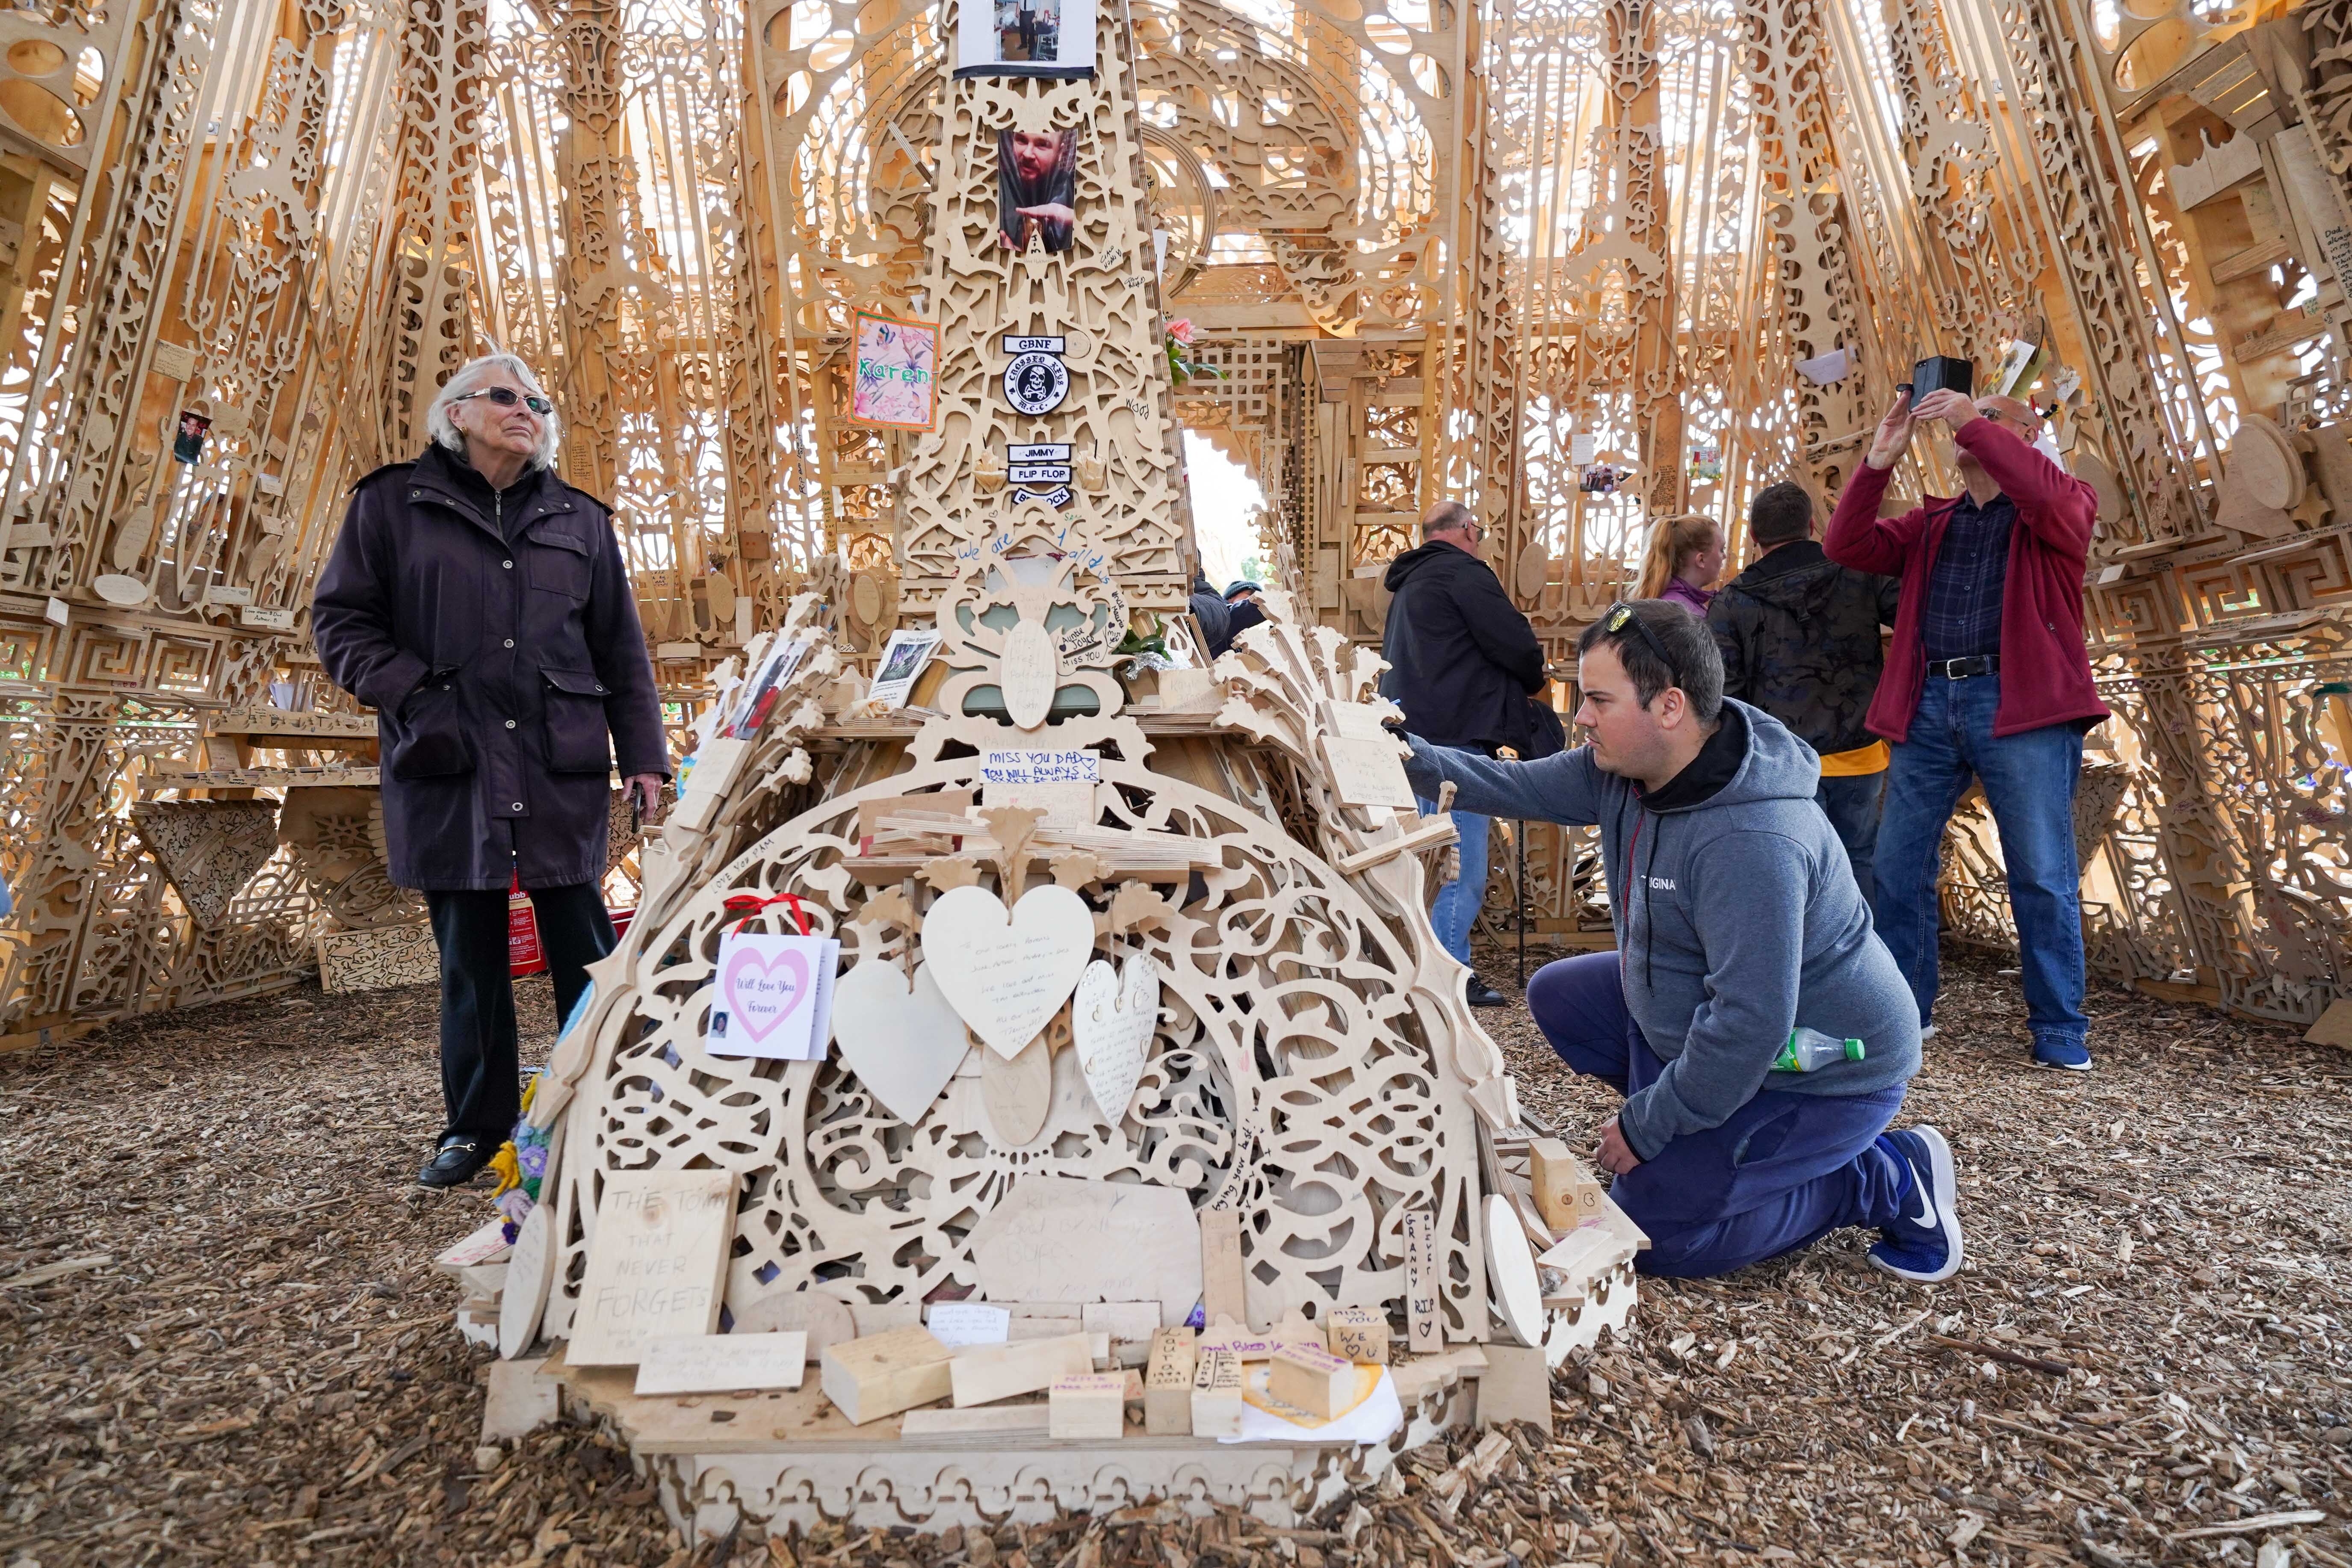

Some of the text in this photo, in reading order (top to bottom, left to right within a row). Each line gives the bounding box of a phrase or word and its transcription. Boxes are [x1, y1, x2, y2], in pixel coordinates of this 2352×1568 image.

[2325, 227, 2343, 238] Dad
[1019, 339, 1052, 350] GBNF
[858, 357, 929, 384] Karen
[1009, 355, 1045, 381] CROSSED
[1025, 449, 1054, 457] JIMMY
[1019, 470, 1066, 478] FLIP FLOP
[958, 542, 980, 561] We
[992, 534, 1013, 554] are
[1062, 627, 1085, 645] Auntie
[1085, 651, 1100, 661] YOU
[990, 752, 1083, 764] MISS YOU DAD
[1006, 769, 1032, 778] WILL
[1034, 766, 1079, 777] ALWAYS
[710, 839, 775, 894] LOVE YOU PAM
[736, 977, 795, 995] Will Love You
[747, 1001, 777, 1014] Forever
[1212, 1184, 1238, 1211] trying
[1233, 1156, 1245, 1181] your
[611, 1190, 664, 1210] THE
[627, 1232, 676, 1246] THAT
[1405, 1214, 1417, 1288] GRANNY
[616, 1256, 687, 1276] NEVER
[595, 1286, 709, 1320] FORGETS
[1339, 1332, 1366, 1343] WE
